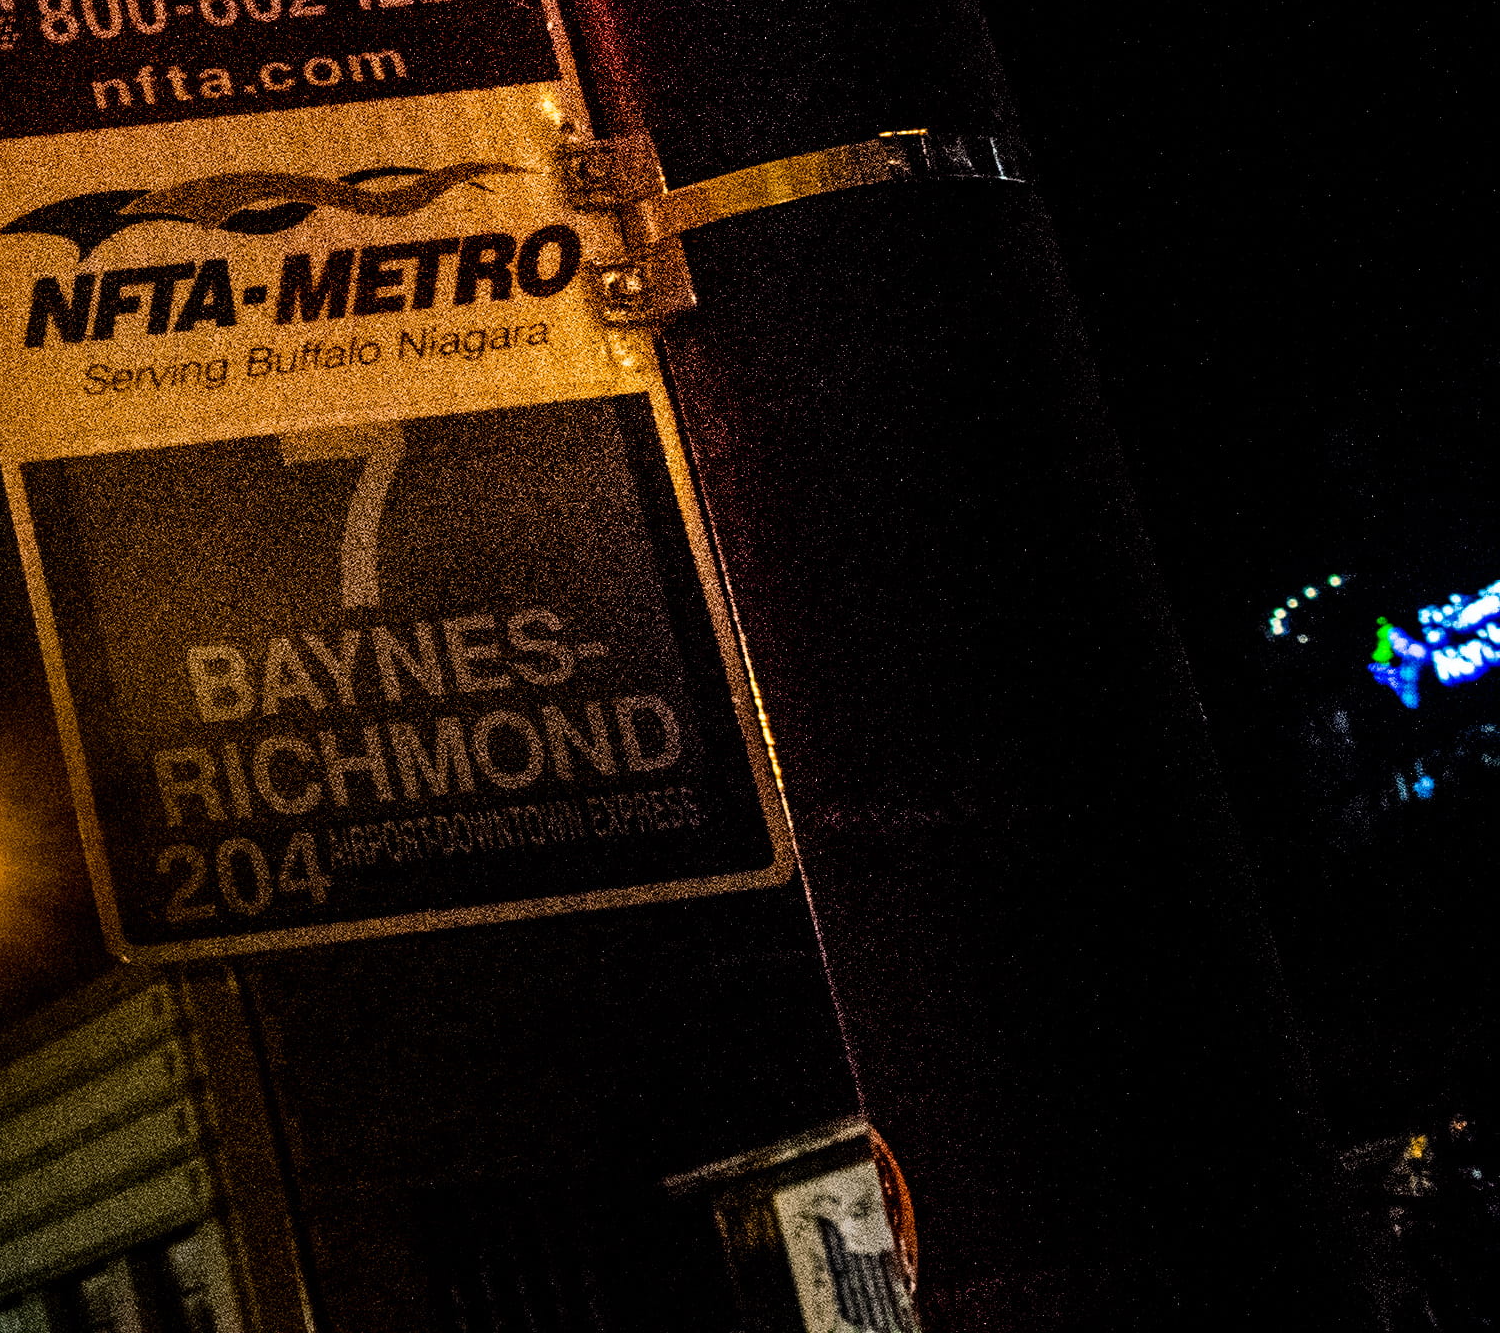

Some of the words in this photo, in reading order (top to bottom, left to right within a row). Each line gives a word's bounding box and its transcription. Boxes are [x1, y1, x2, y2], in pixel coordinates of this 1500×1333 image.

[92, 49, 408, 110] nfta.com
[83, 355, 228, 396] Serving
[247, 337, 380, 379] Buffalo
[399, 317, 550, 360] Niagara
[279, 421, 406, 610] 7
[186, 608, 610, 724] BAYNES-
[153, 695, 683, 828] RICHMOND
[156, 828, 331, 924] 204
